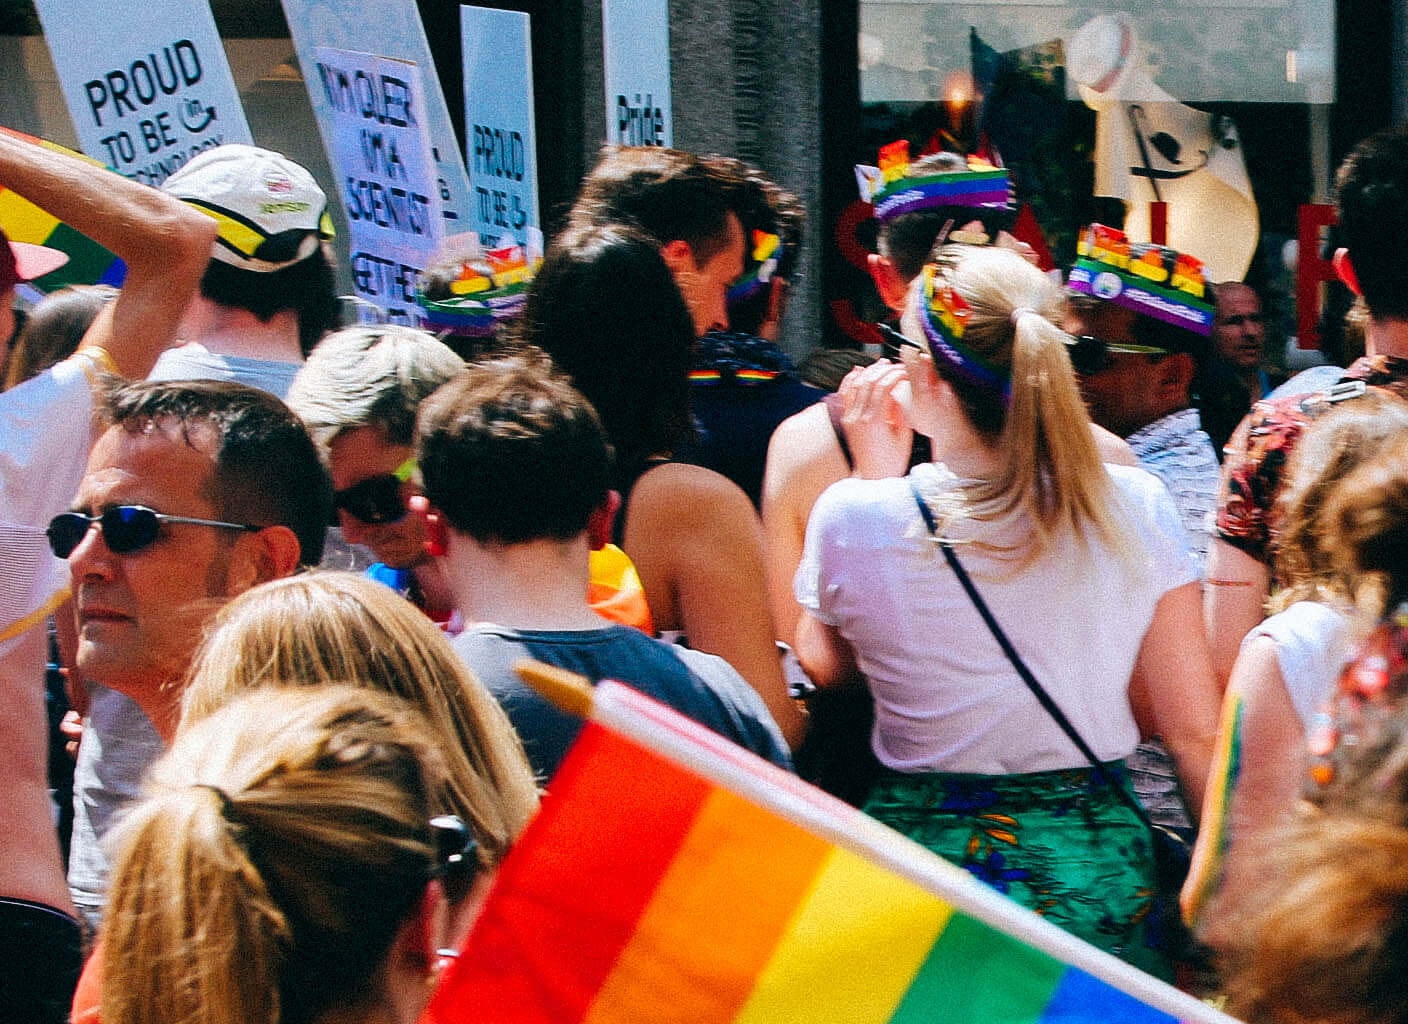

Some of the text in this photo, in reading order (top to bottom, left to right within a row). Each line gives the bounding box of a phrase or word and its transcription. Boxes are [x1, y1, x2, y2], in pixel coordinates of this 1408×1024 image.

[84, 39, 202, 127] PROUD
[101, 130, 138, 170] TO
[139, 111, 178, 154] BE
[616, 93, 665, 147] Pride
